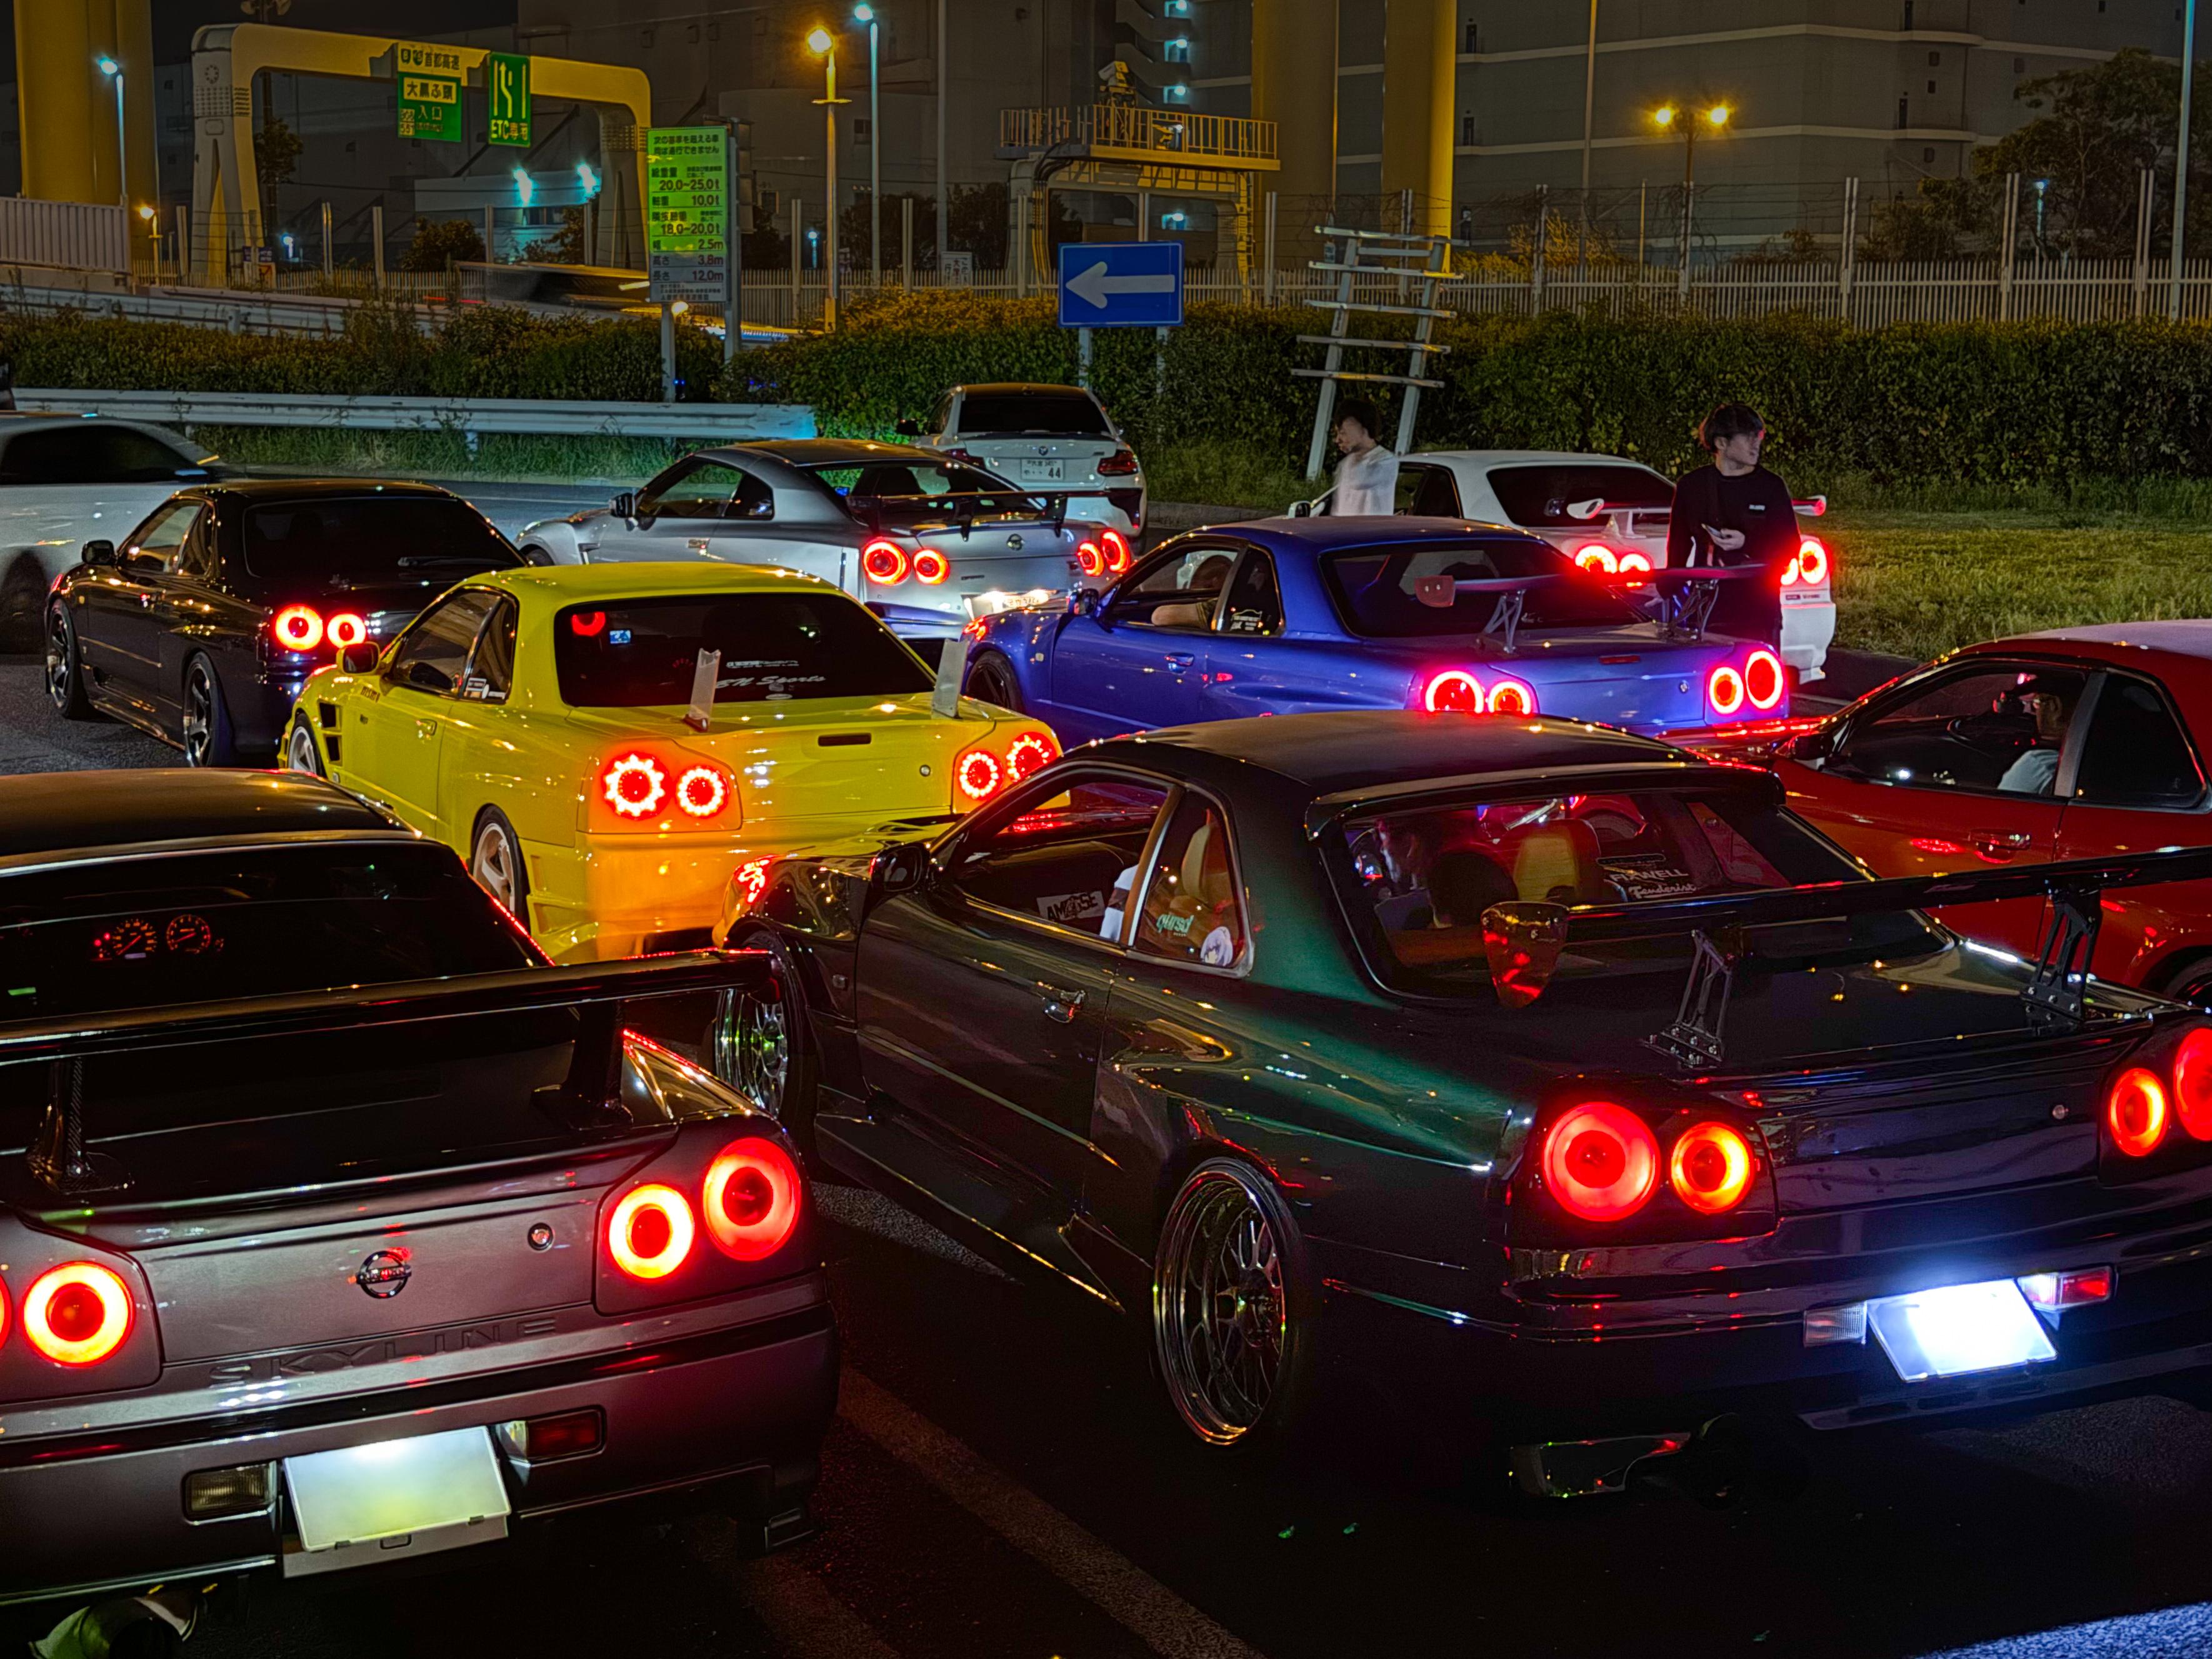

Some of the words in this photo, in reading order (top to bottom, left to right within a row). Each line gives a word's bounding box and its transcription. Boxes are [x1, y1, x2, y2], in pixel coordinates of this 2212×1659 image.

[407, 81, 453, 100] 大黒ふ頭
[418, 105, 442, 121] 入口
[698, 254, 723, 266] 3.8m
[210, 1316, 556, 1382] SKYLINE
